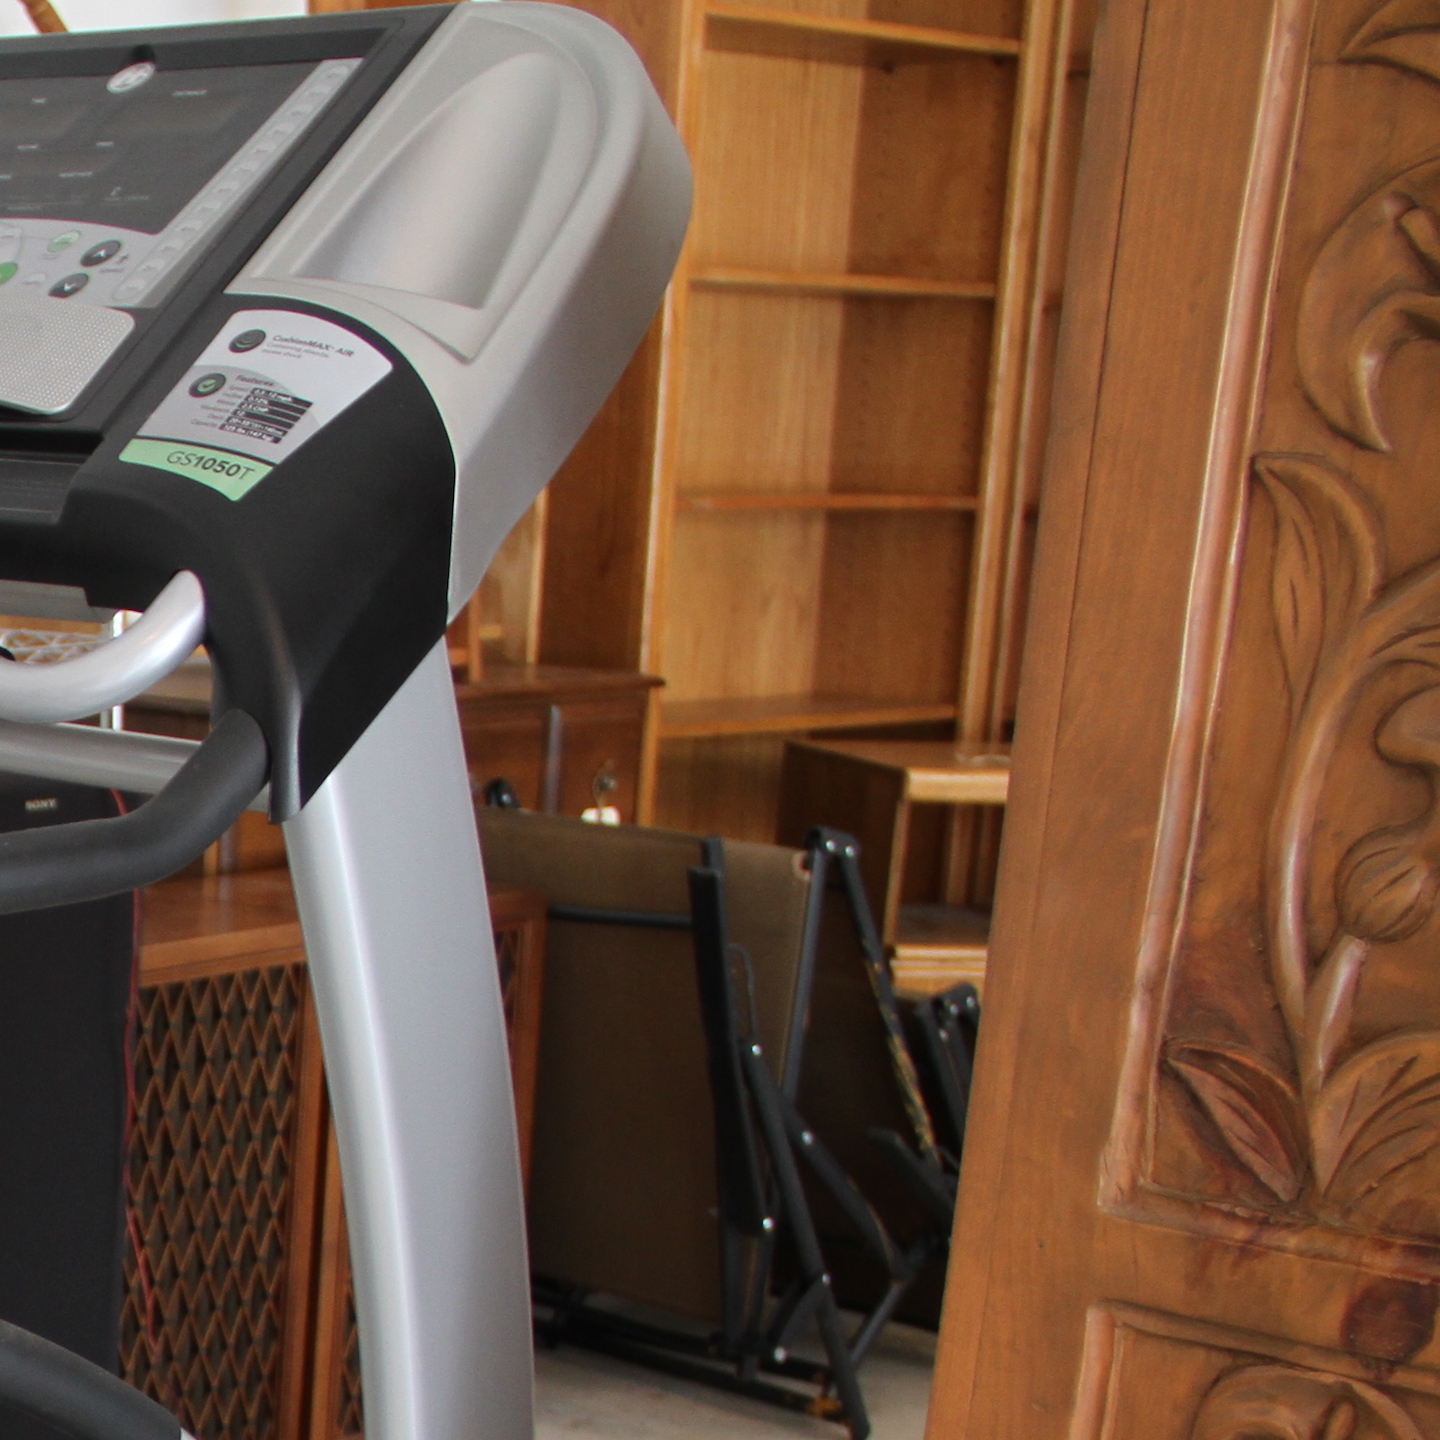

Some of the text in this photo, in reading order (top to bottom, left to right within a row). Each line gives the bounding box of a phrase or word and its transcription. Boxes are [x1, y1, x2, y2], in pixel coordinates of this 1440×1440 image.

[336, 346, 355, 357] AIR
[166, 450, 256, 481] GS1050T
[25, 797, 58, 811] SONY
